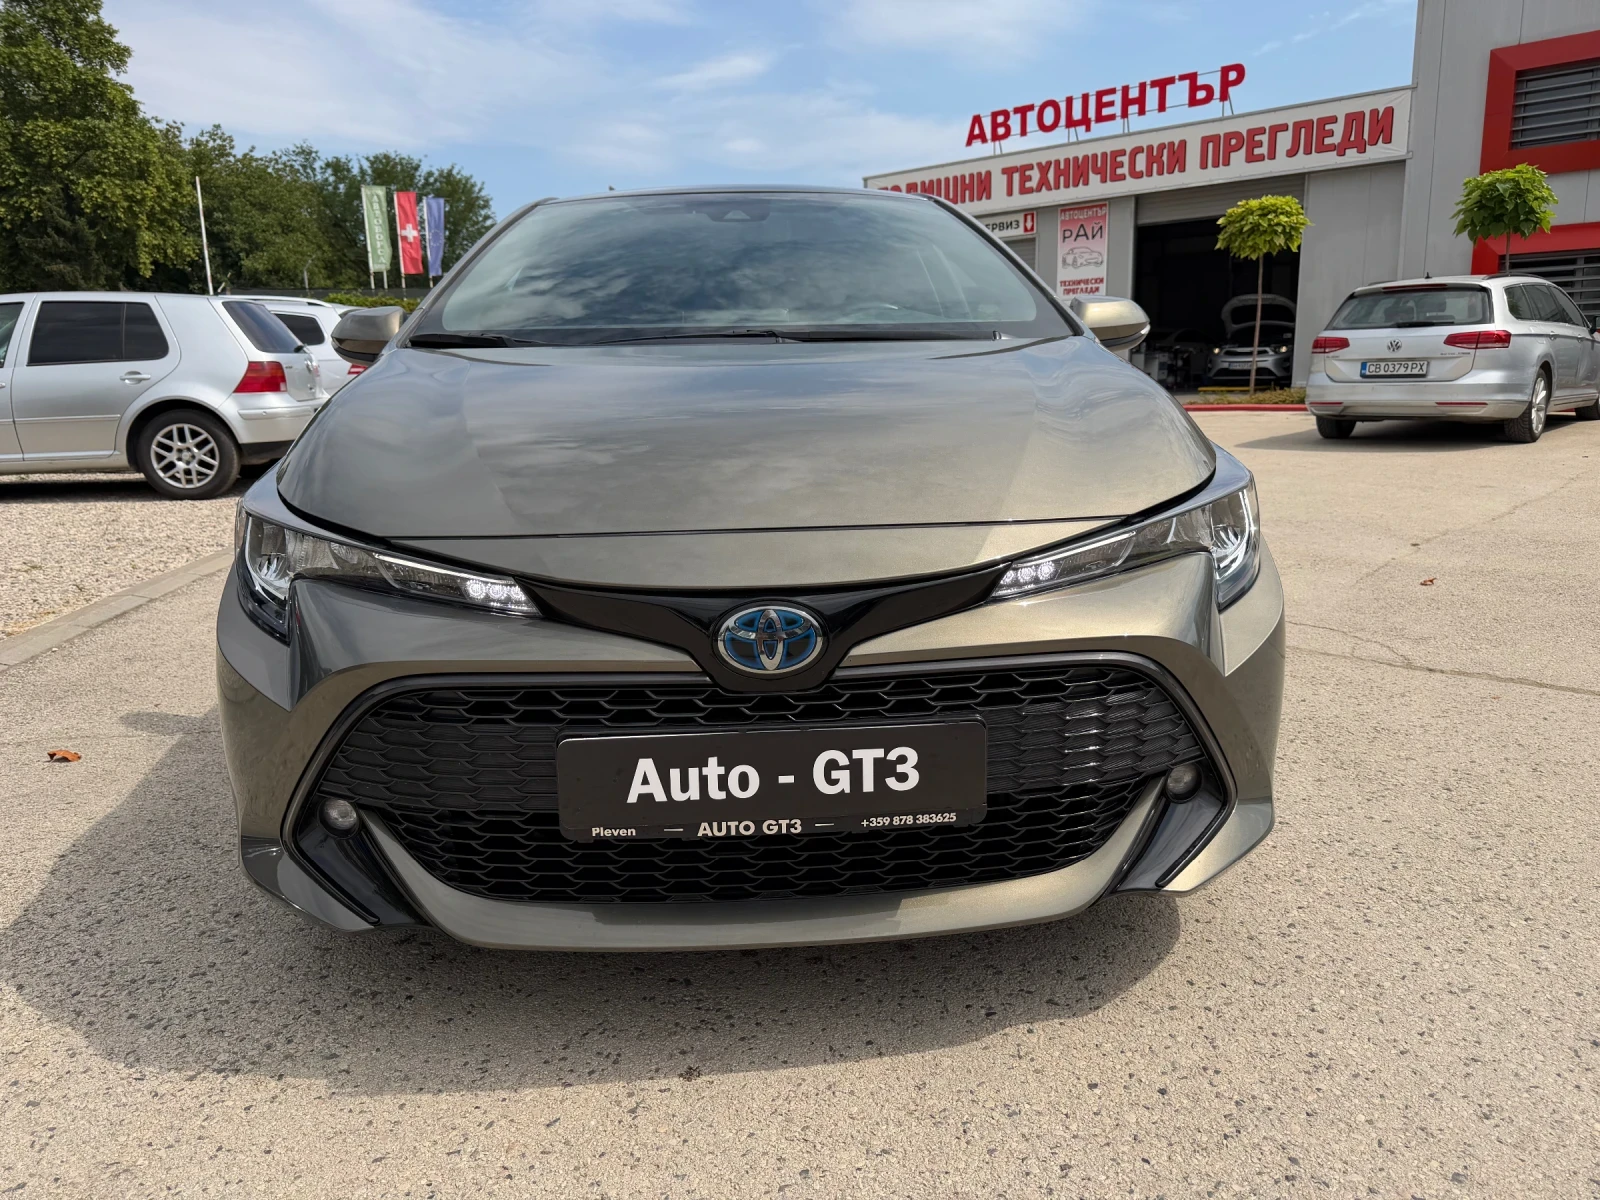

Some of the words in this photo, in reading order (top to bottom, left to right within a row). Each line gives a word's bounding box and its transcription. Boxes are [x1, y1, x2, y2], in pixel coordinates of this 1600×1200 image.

[965, 63, 1246, 147] АВТОЦЕНТЪР
[877, 169, 992, 205] ИШНИ
[1001, 139, 1187, 196] ТЕХНИЧЕСКИ
[1199, 106, 1395, 170] ПРЕГЛЕДИ
[1060, 207, 1107, 220] АВТОЦЕНТЪР
[1060, 277, 1105, 287] ТЕХНИЧЕСКИ
[1063, 286, 1100, 295] ПРЕГЛЕДИ
[1367, 361, 1381, 374] CB
[1383, 362, 1409, 373] 0379
[1410, 361, 1425, 373] PX
[627, 756, 760, 803] Auto
[812, 746, 920, 795] GT3
[591, 826, 636, 838] Pleven
[698, 820, 755, 837] AUTO
[762, 819, 803, 834] GT3
[861, 816, 890, 828] +359
[892, 814, 914, 826] 878
[915, 812, 957, 825] 383625
